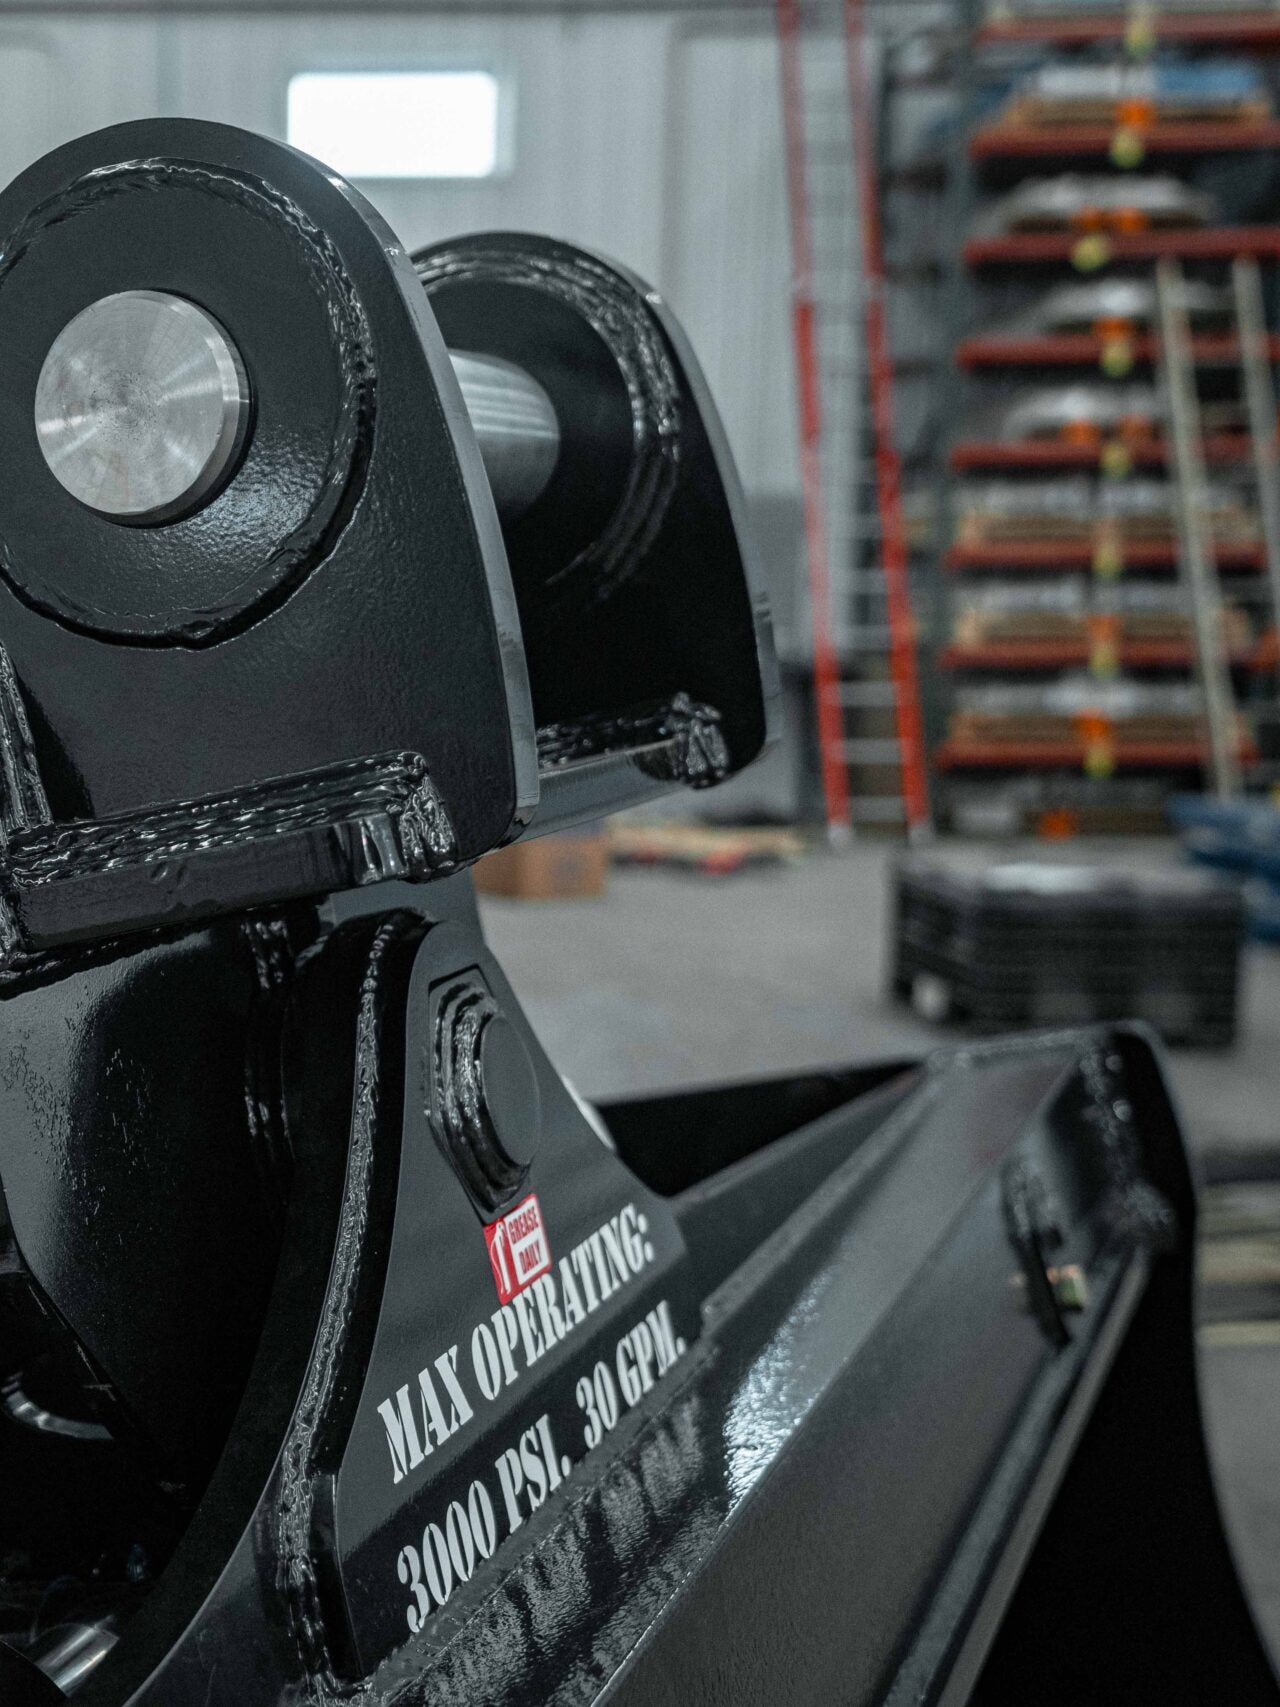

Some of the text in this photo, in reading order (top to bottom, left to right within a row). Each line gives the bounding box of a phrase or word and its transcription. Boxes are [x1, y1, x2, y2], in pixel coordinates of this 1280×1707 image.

[508, 1206, 539, 1245] GREASE
[518, 1240, 542, 1275] DAILY
[377, 1202, 654, 1485] MAX OPERATING:
[397, 1299, 686, 1633] 3000 PSI. 30 GPM.
